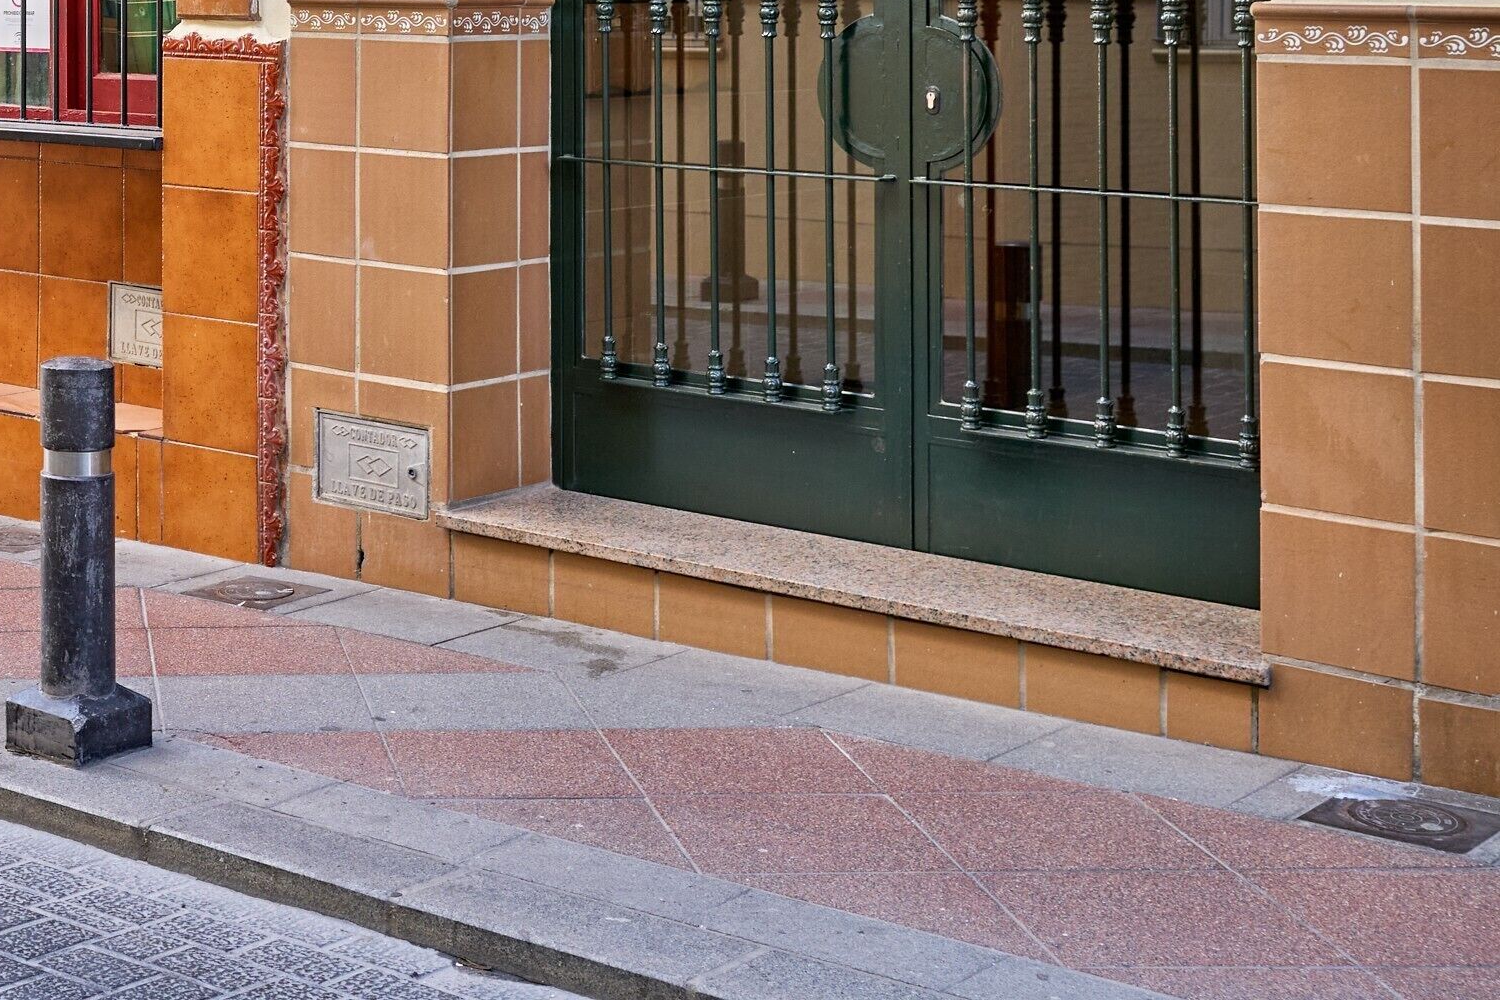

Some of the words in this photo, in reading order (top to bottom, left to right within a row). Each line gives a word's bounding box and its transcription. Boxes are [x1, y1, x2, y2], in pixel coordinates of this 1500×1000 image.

[349, 427, 398, 449] CONTADOR
[332, 479, 367, 500] LLAVE
[370, 486, 385, 503] DE
[388, 491, 418, 510] PASO
